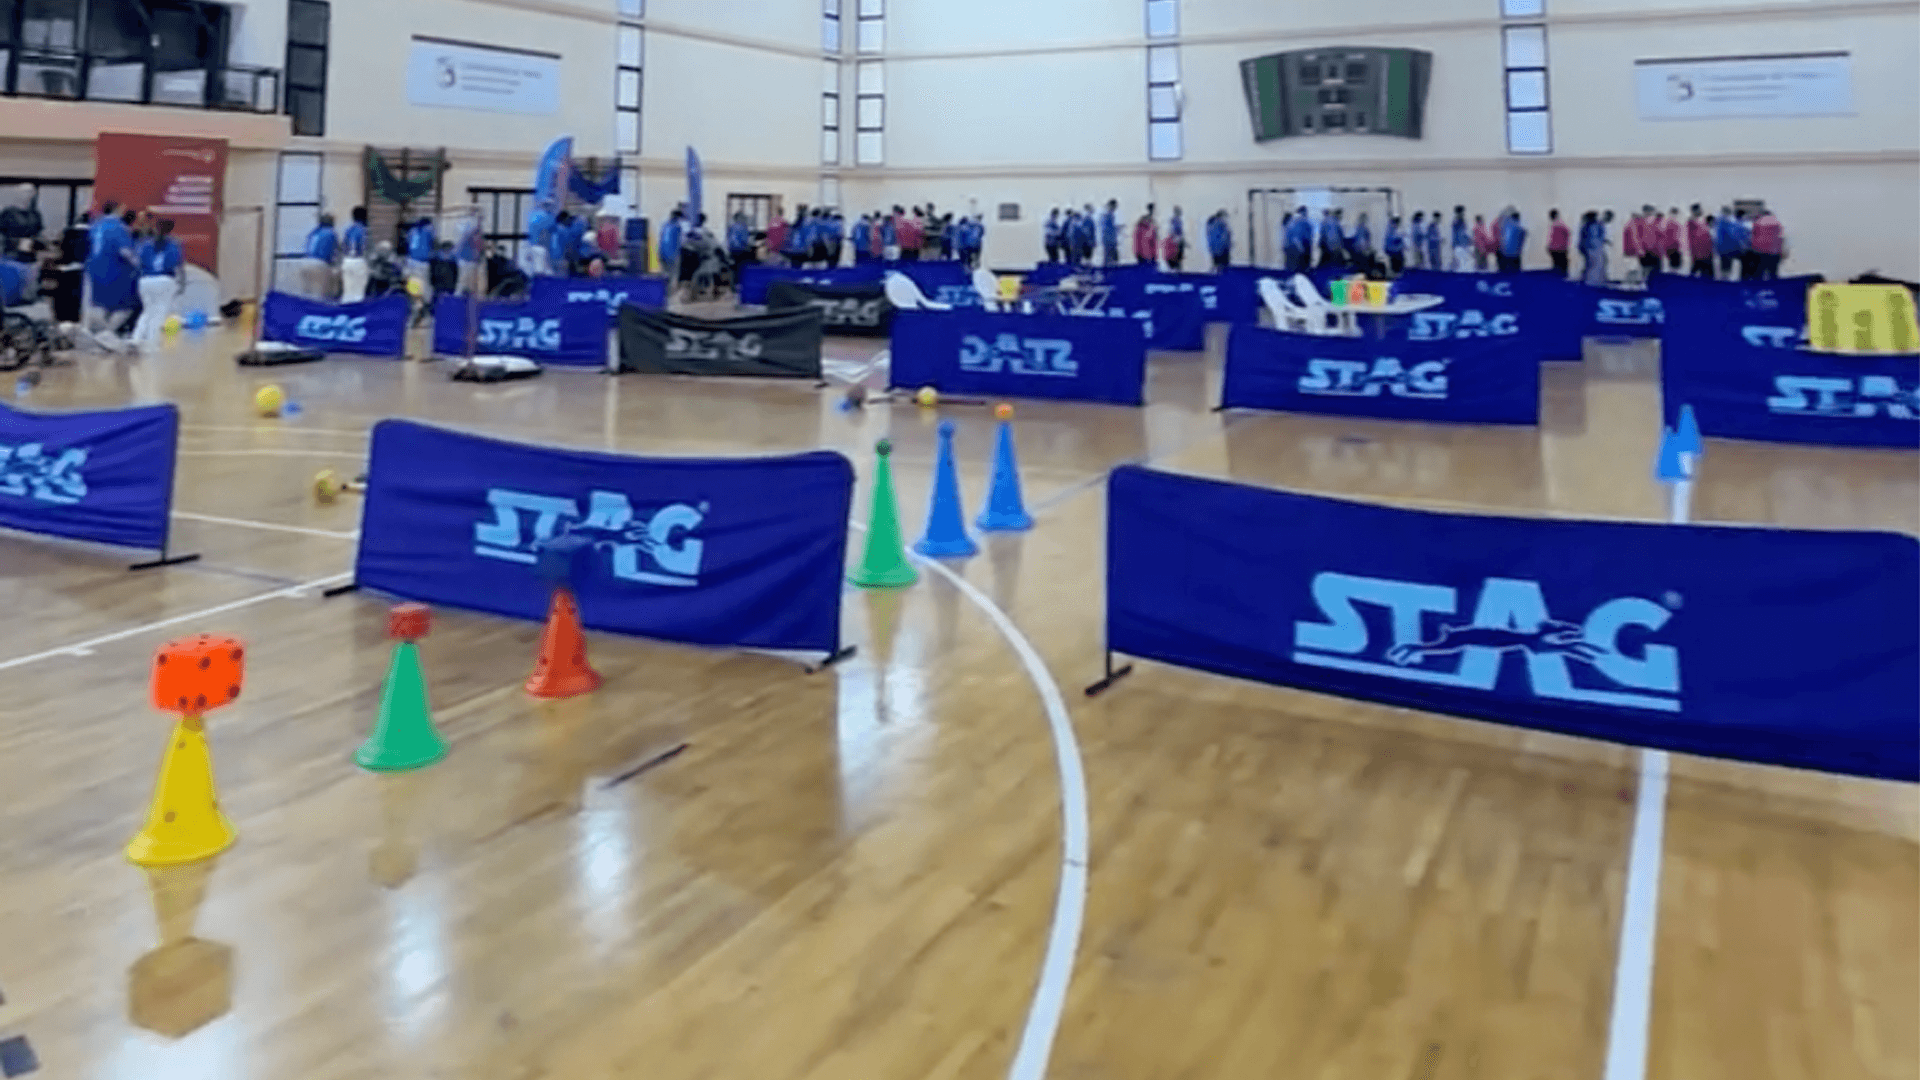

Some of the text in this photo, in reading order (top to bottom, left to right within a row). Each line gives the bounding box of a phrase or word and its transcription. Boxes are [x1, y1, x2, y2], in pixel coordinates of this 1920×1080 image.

[1408, 310, 1520, 340] STAG
[1596, 298, 1666, 324] STA
[478, 317, 561, 350] STAG
[1298, 358, 1448, 399] STAG
[1767, 375, 1920, 420] STA
[1293, 571, 1681, 711] STAG
